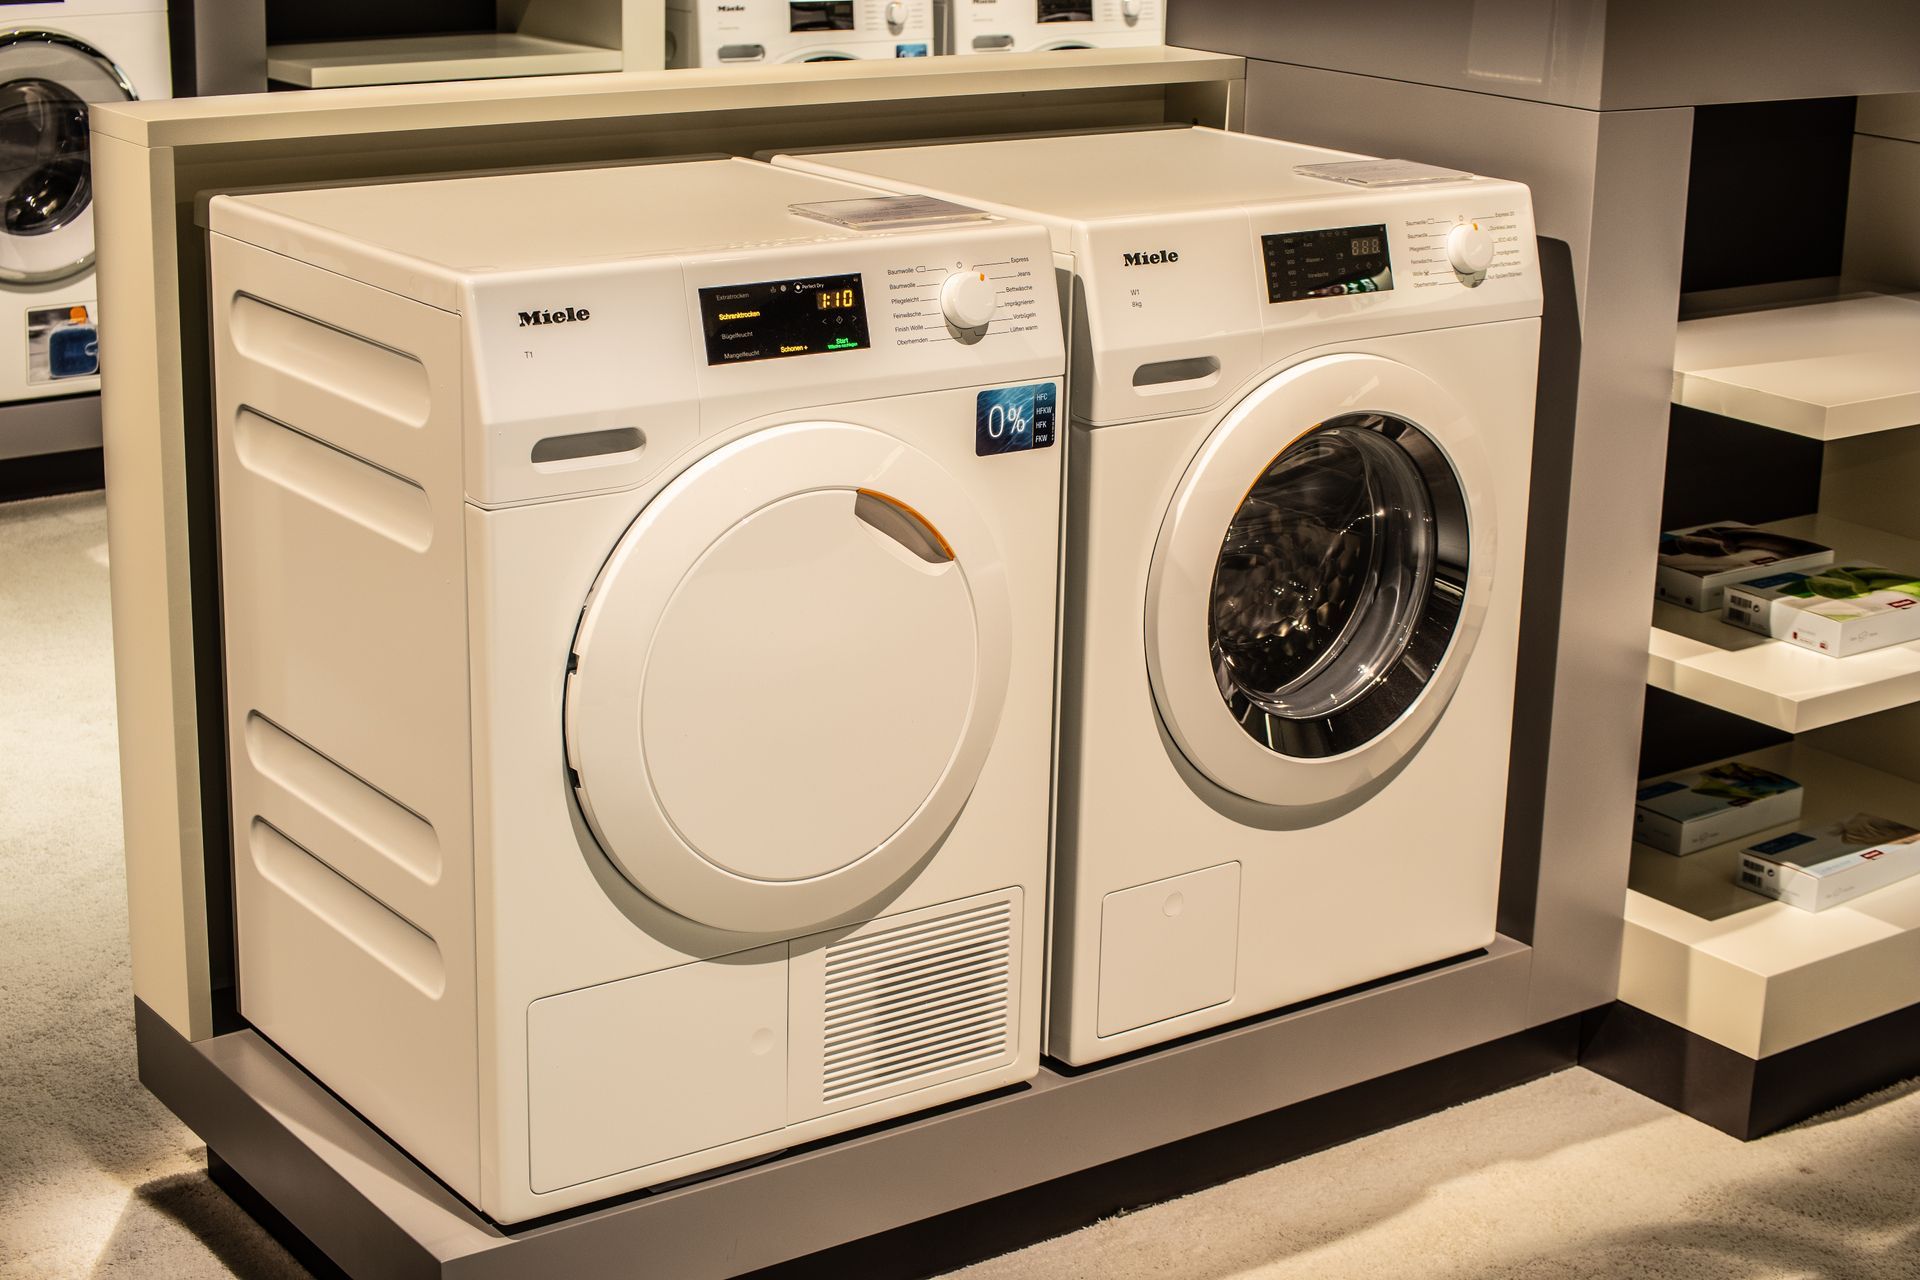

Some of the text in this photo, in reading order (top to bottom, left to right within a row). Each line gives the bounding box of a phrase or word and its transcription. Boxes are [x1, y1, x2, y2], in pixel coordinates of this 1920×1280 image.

[1123, 250, 1179, 267] Miele
[887, 267, 914, 275] Baumwolle
[889, 282, 916, 290] Baumwolle
[1005, 285, 1033, 293] Bettwäsche
[715, 292, 749, 301] Extratrocken
[822, 289, 853, 309] 1:10
[1004, 299, 1035, 307] Imprägnieren
[518, 307, 590, 327] Miele
[718, 310, 760, 321] Schranktrocken
[893, 311, 922, 319] Feinwäsche
[721, 331, 753, 340] Bügelfeucht
[723, 350, 759, 360] Mangelfeucht
[1036, 392, 1047, 400] HFC
[1036, 406, 1052, 414] HFKW
[988, 404, 1025, 437] 0%
[1035, 420, 1047, 428] HFK
[1035, 434, 1047, 442] FKW
